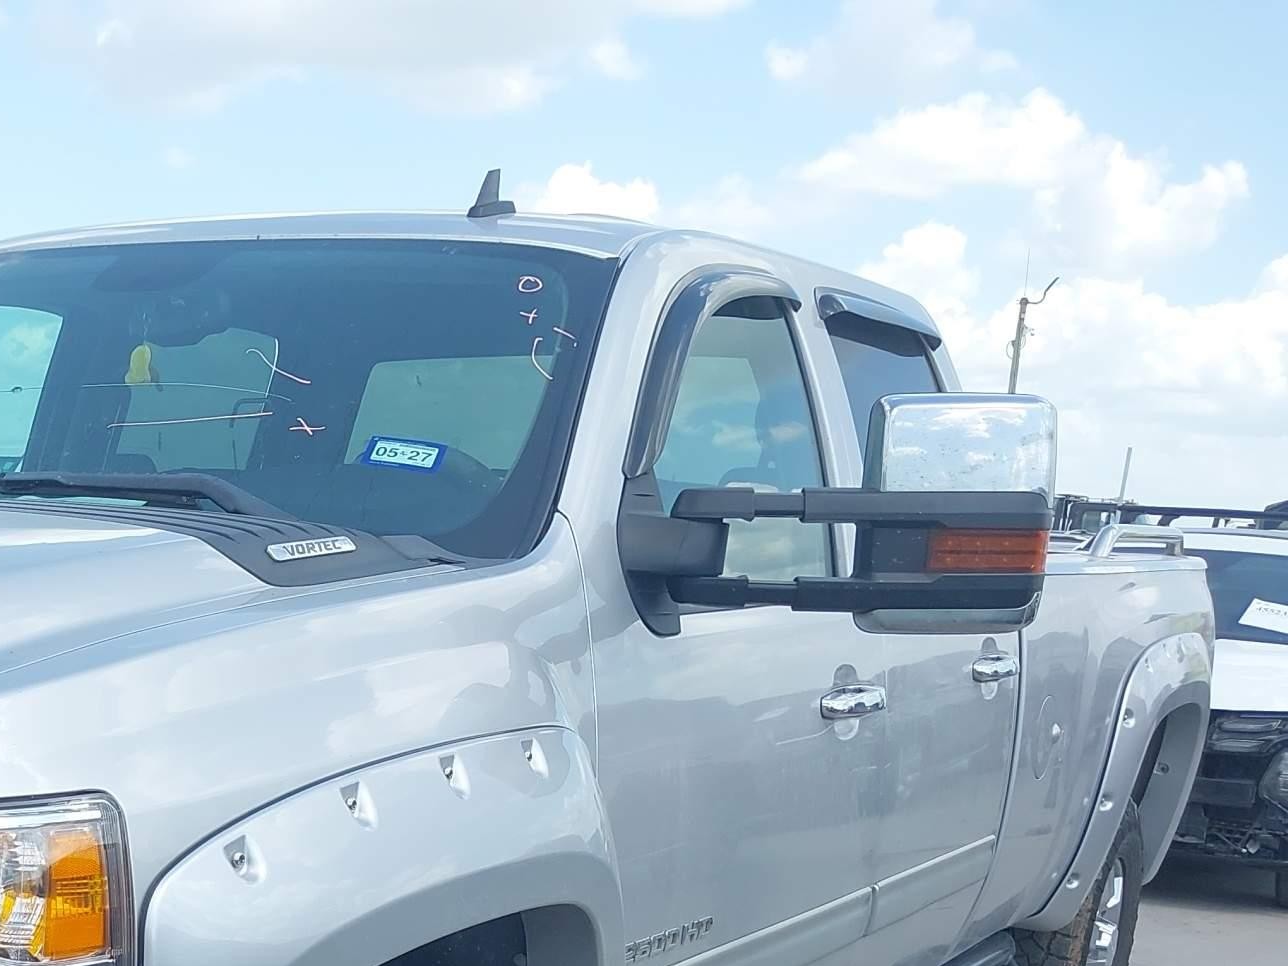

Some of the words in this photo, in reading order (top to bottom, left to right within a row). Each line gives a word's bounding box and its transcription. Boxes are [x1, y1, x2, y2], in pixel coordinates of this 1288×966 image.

[374, 446, 400, 458] 05
[407, 450, 433, 462] 27
[281, 538, 342, 557] VORTEC
